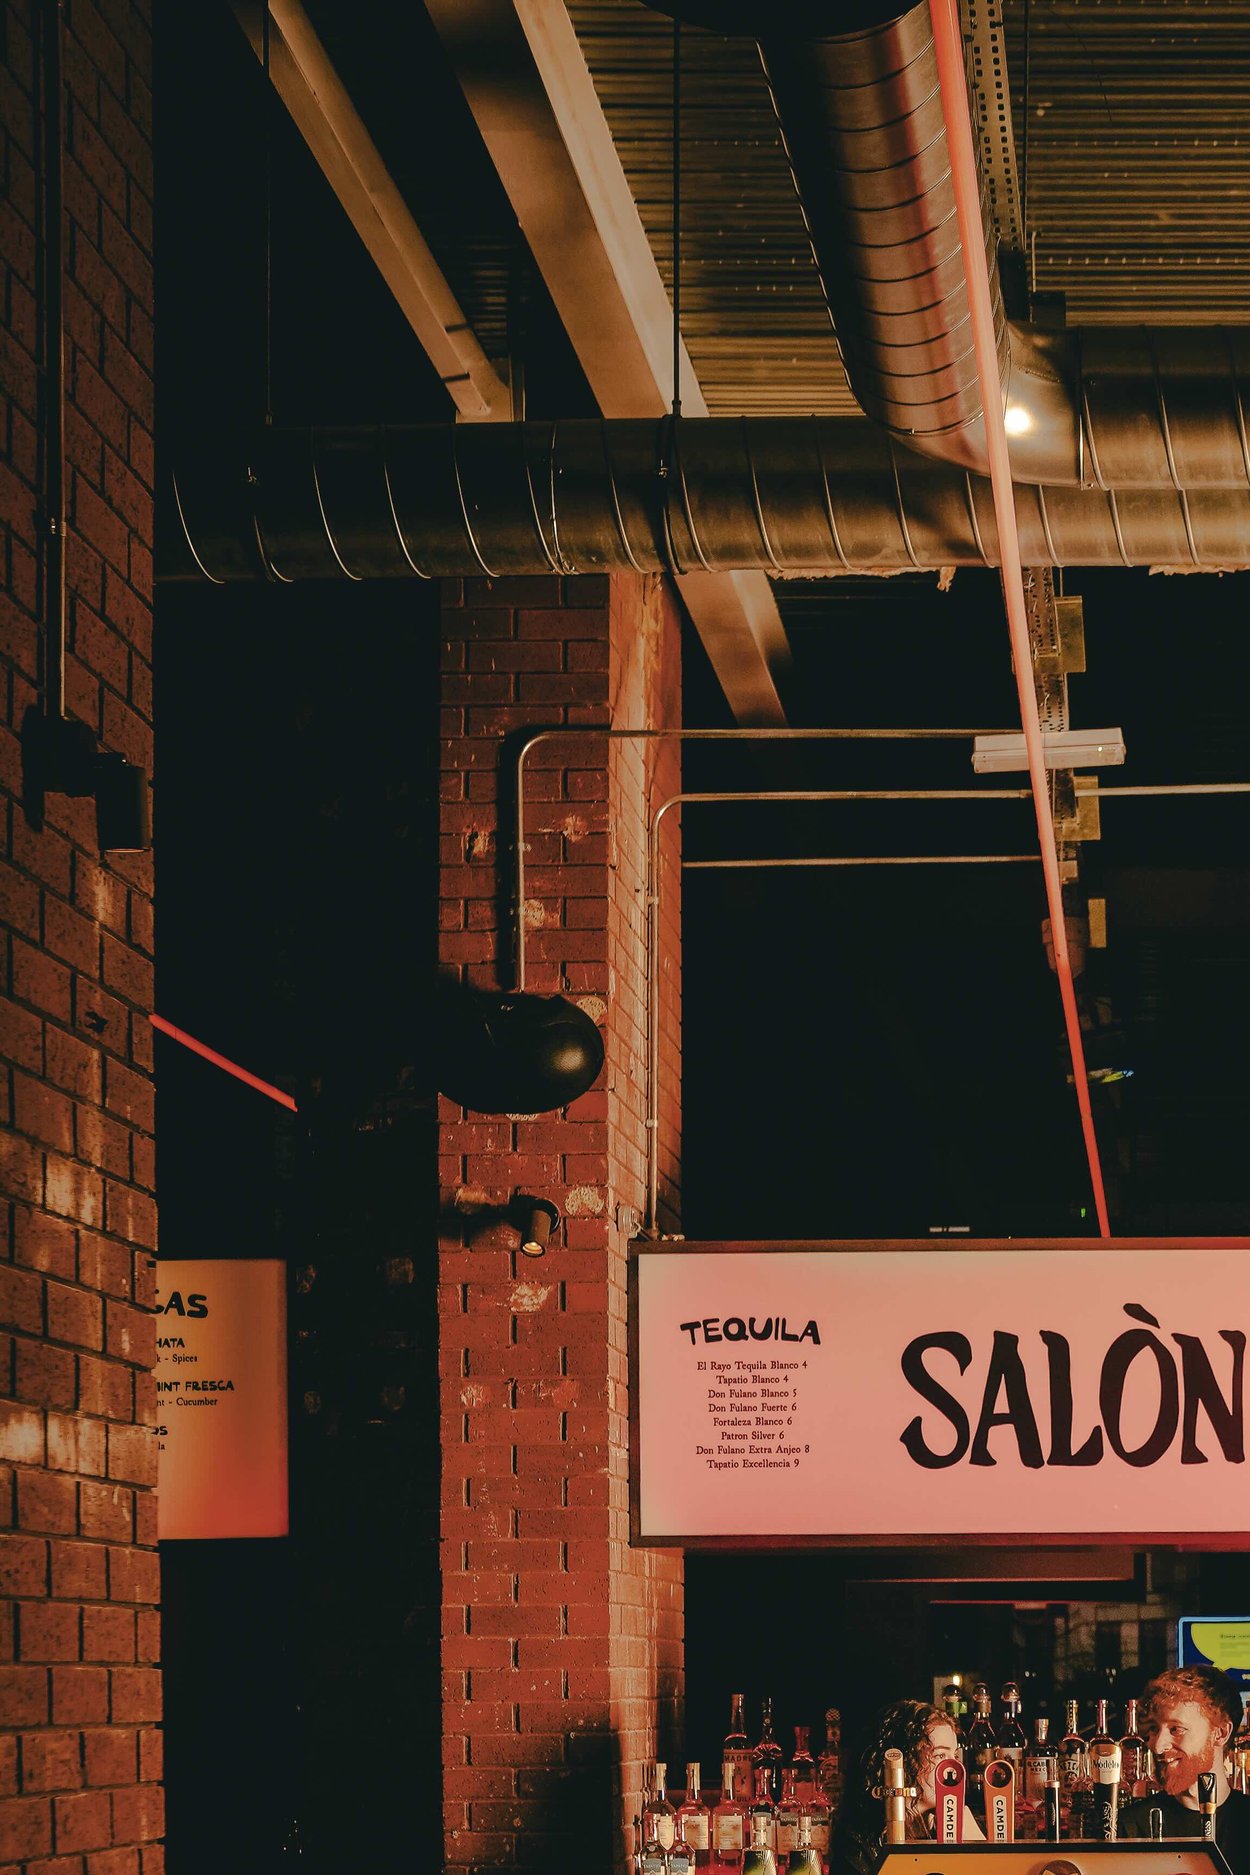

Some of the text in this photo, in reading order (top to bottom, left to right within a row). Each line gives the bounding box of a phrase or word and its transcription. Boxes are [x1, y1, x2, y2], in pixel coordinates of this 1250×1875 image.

[680, 1317, 822, 1346] TEQUILA
[172, 1353, 198, 1365] Spices
[697, 1360, 808, 1374] El Rayo Tequila Blanco 4
[185, 1380, 235, 1392] FRESCA
[716, 1375, 789, 1386] Tapatio Blanco 4
[899, 1302, 1247, 1470] SALÒN
[708, 1388, 797, 1399] Don Fulano Blanco 5
[176, 1397, 218, 1407] Cucumber
[708, 1402, 797, 1413] Don Fulano Fuerte 6
[713, 1416, 793, 1427] Fortaleza Blanco 6
[721, 1430, 785, 1441] Patron Silver 6
[696, 1446, 714, 1455] Don
[717, 1445, 746, 1455] Fulano
[749, 1445, 772, 1454] Extra
[804, 1444, 810, 1454] 8
[706, 1459, 800, 1471] Tapatio Excellencia 9
[946, 1798, 954, 1842] CAMDE
[996, 1799, 1005, 1842] CAMDE
